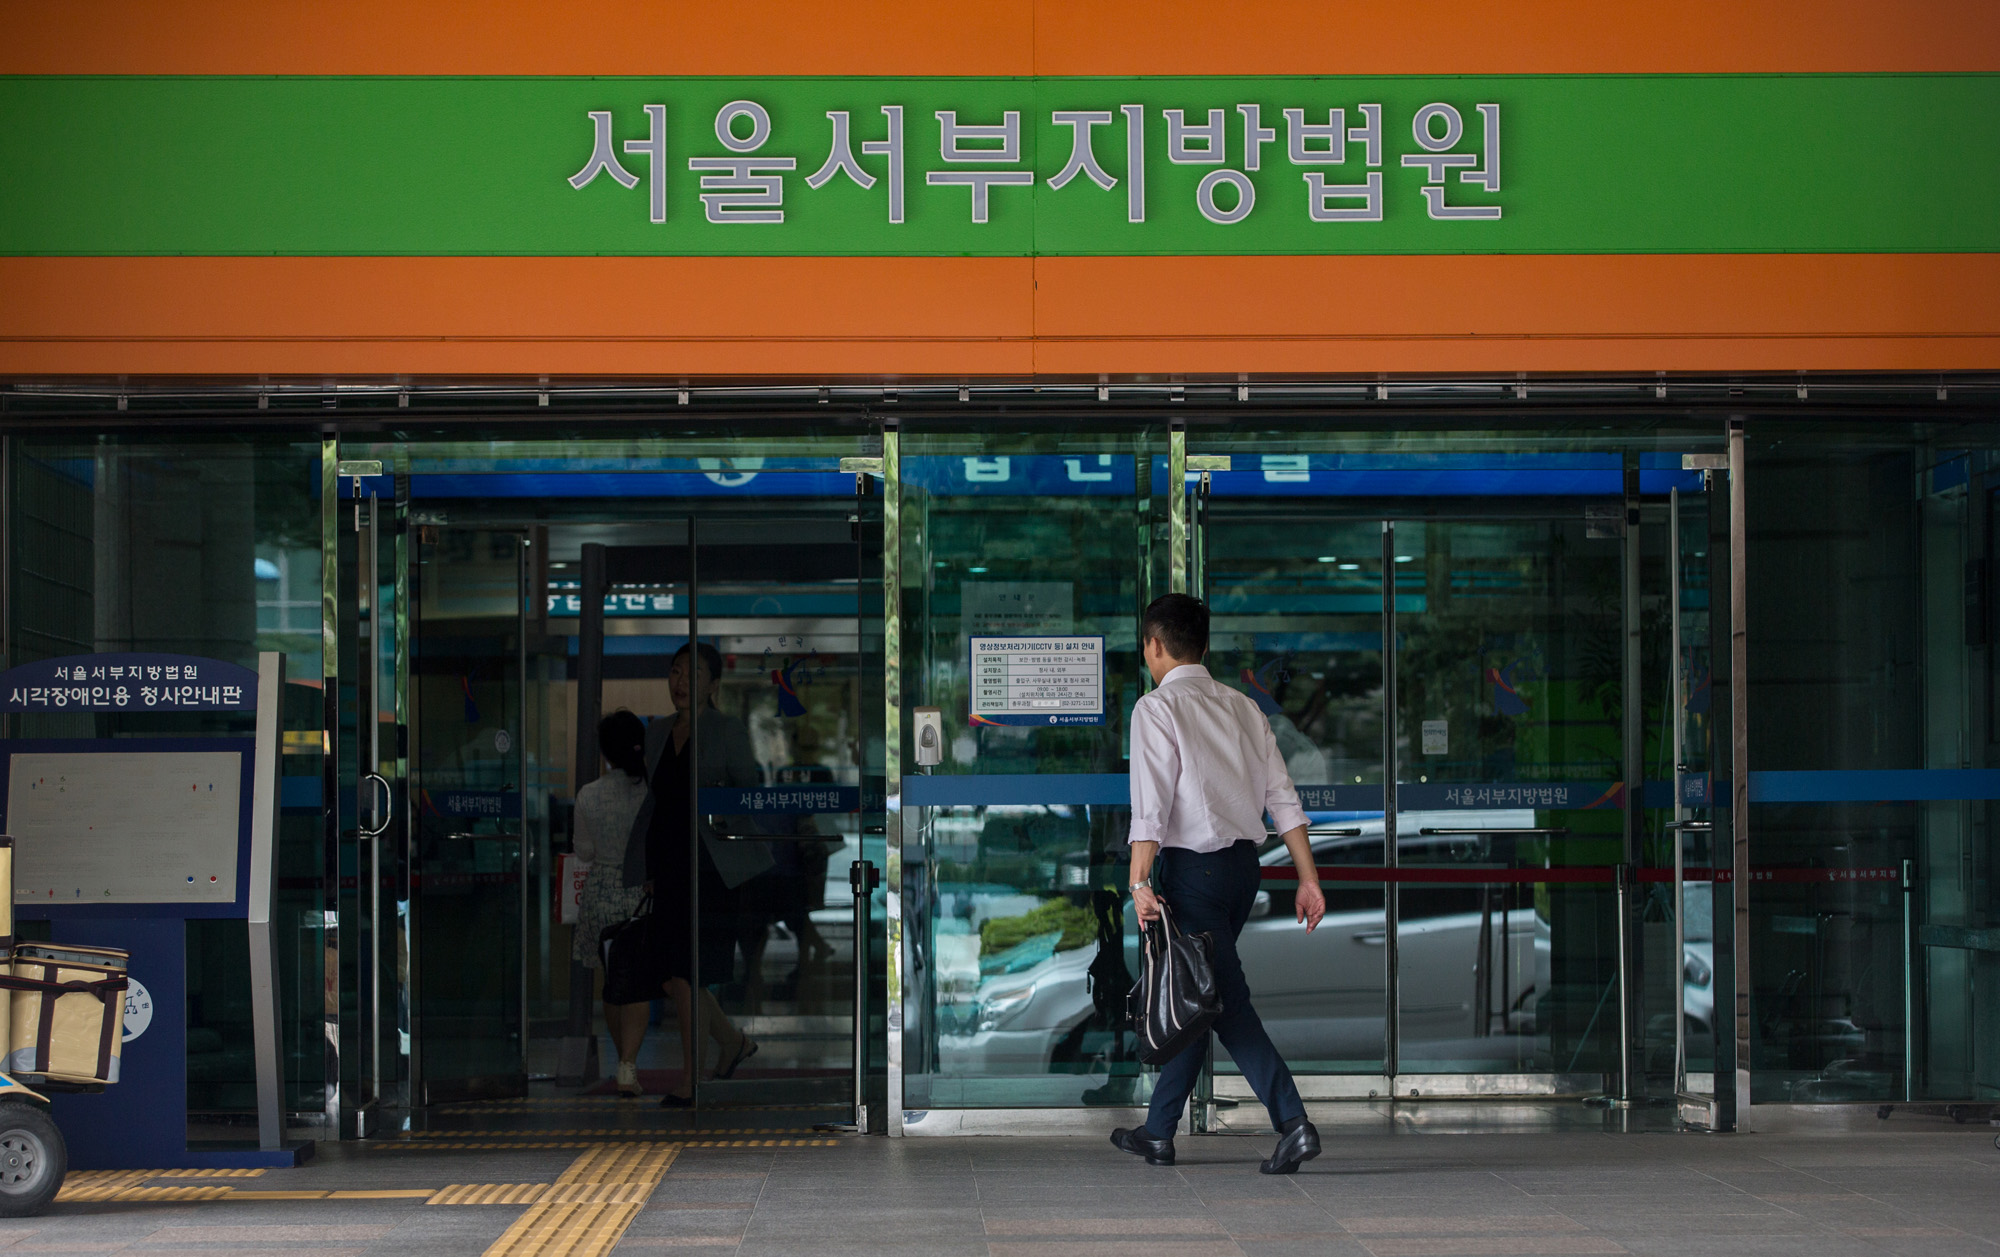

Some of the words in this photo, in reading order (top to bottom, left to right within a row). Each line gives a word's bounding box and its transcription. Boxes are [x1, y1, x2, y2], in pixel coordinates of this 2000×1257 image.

[567, 100, 1502, 225] 서울서부지방법원
[1081, 642, 1095, 650] 안내
[55, 665, 198, 680] 서울서부지방법원
[9, 686, 131, 706] 시각장애인용
[140, 685, 243, 706] 청사안내판
[448, 795, 503, 814] 서울서부지방법원
[740, 792, 840, 809] 서울서부지방법원
[1445, 787, 1568, 805] 서울서부지방법원
